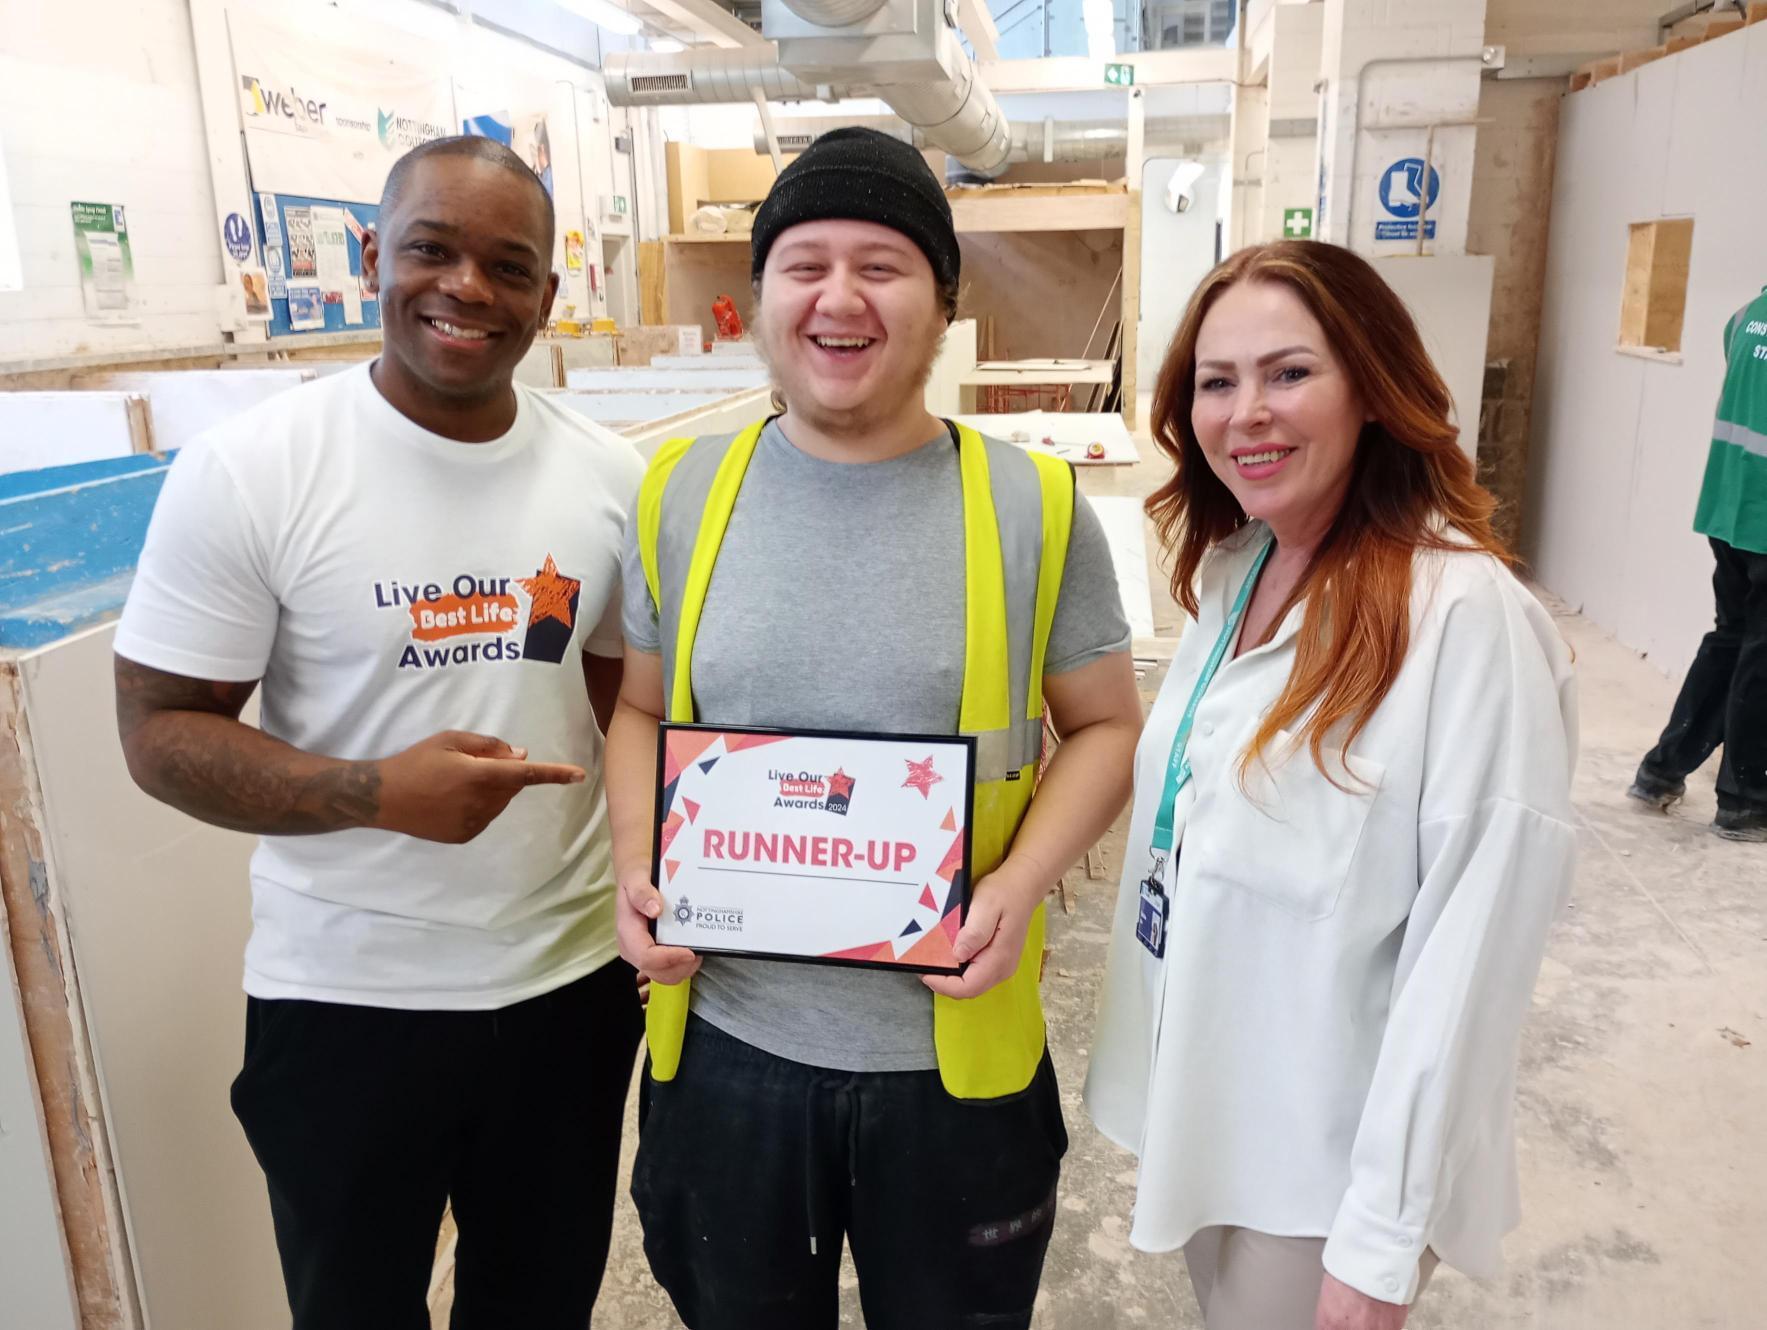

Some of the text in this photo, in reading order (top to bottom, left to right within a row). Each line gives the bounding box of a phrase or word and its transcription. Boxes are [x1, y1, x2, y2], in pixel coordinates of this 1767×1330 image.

[1745, 320, 1767, 337] CONS
[374, 575, 511, 608] Live Our
[420, 602, 514, 629] Best Life
[398, 637, 521, 668] Awards
[768, 769, 823, 783] Live Our
[783, 783, 823, 794] Best Life
[774, 796, 847, 812] Awards 2024
[703, 828, 918, 872] RUNNER-UP
[696, 912, 744, 924] POLICE
